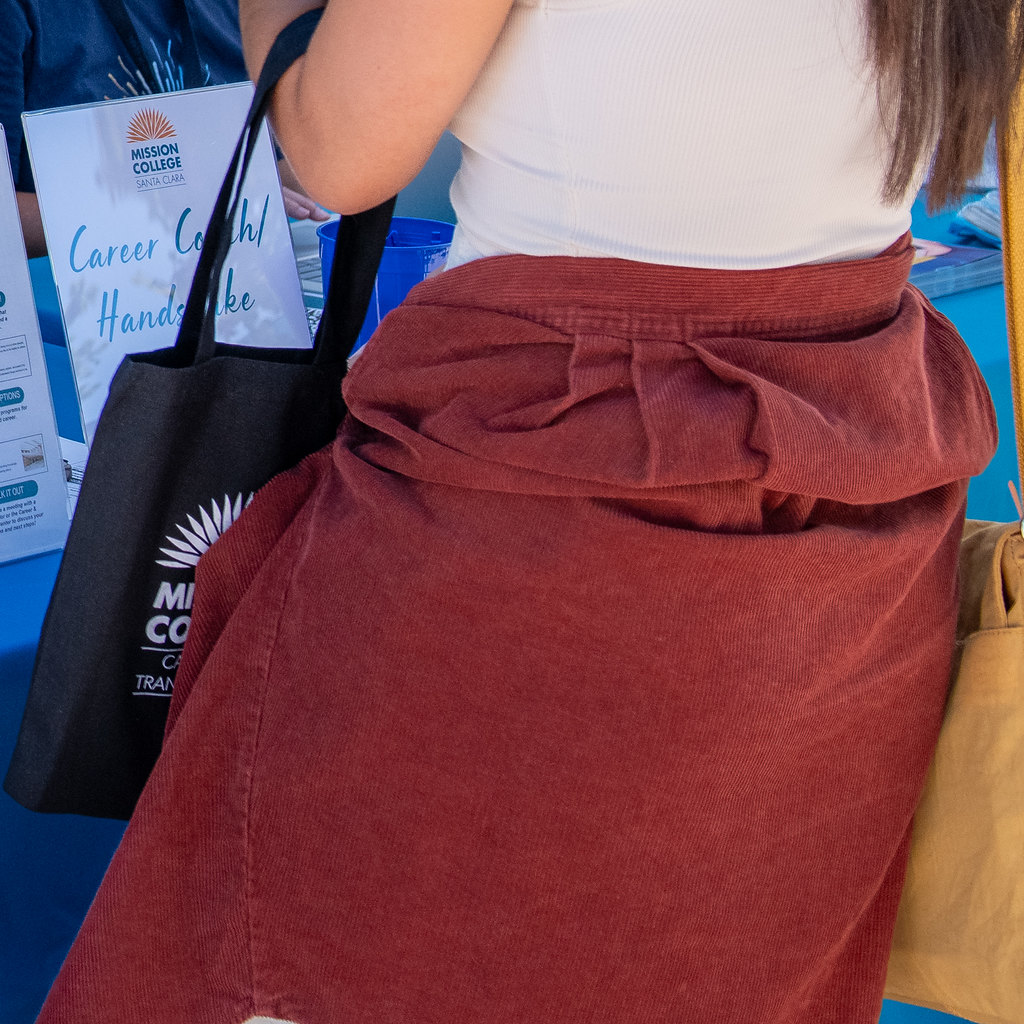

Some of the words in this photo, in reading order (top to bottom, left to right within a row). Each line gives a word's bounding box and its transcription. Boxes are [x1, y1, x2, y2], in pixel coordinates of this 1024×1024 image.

[131, 142, 179, 161] MISSION
[132, 156, 182, 175] COLLEGE
[136, 175, 161, 189] SANTA
[162, 172, 186, 185] CLARA
[69, 224, 159, 273] Career
[175, 194, 270, 254] Coh/
[97, 267, 255, 342] Handske
[0, 407, 20, 417] programs
[6, 489, 12, 497] IT
[12, 486, 24, 495] OUT
